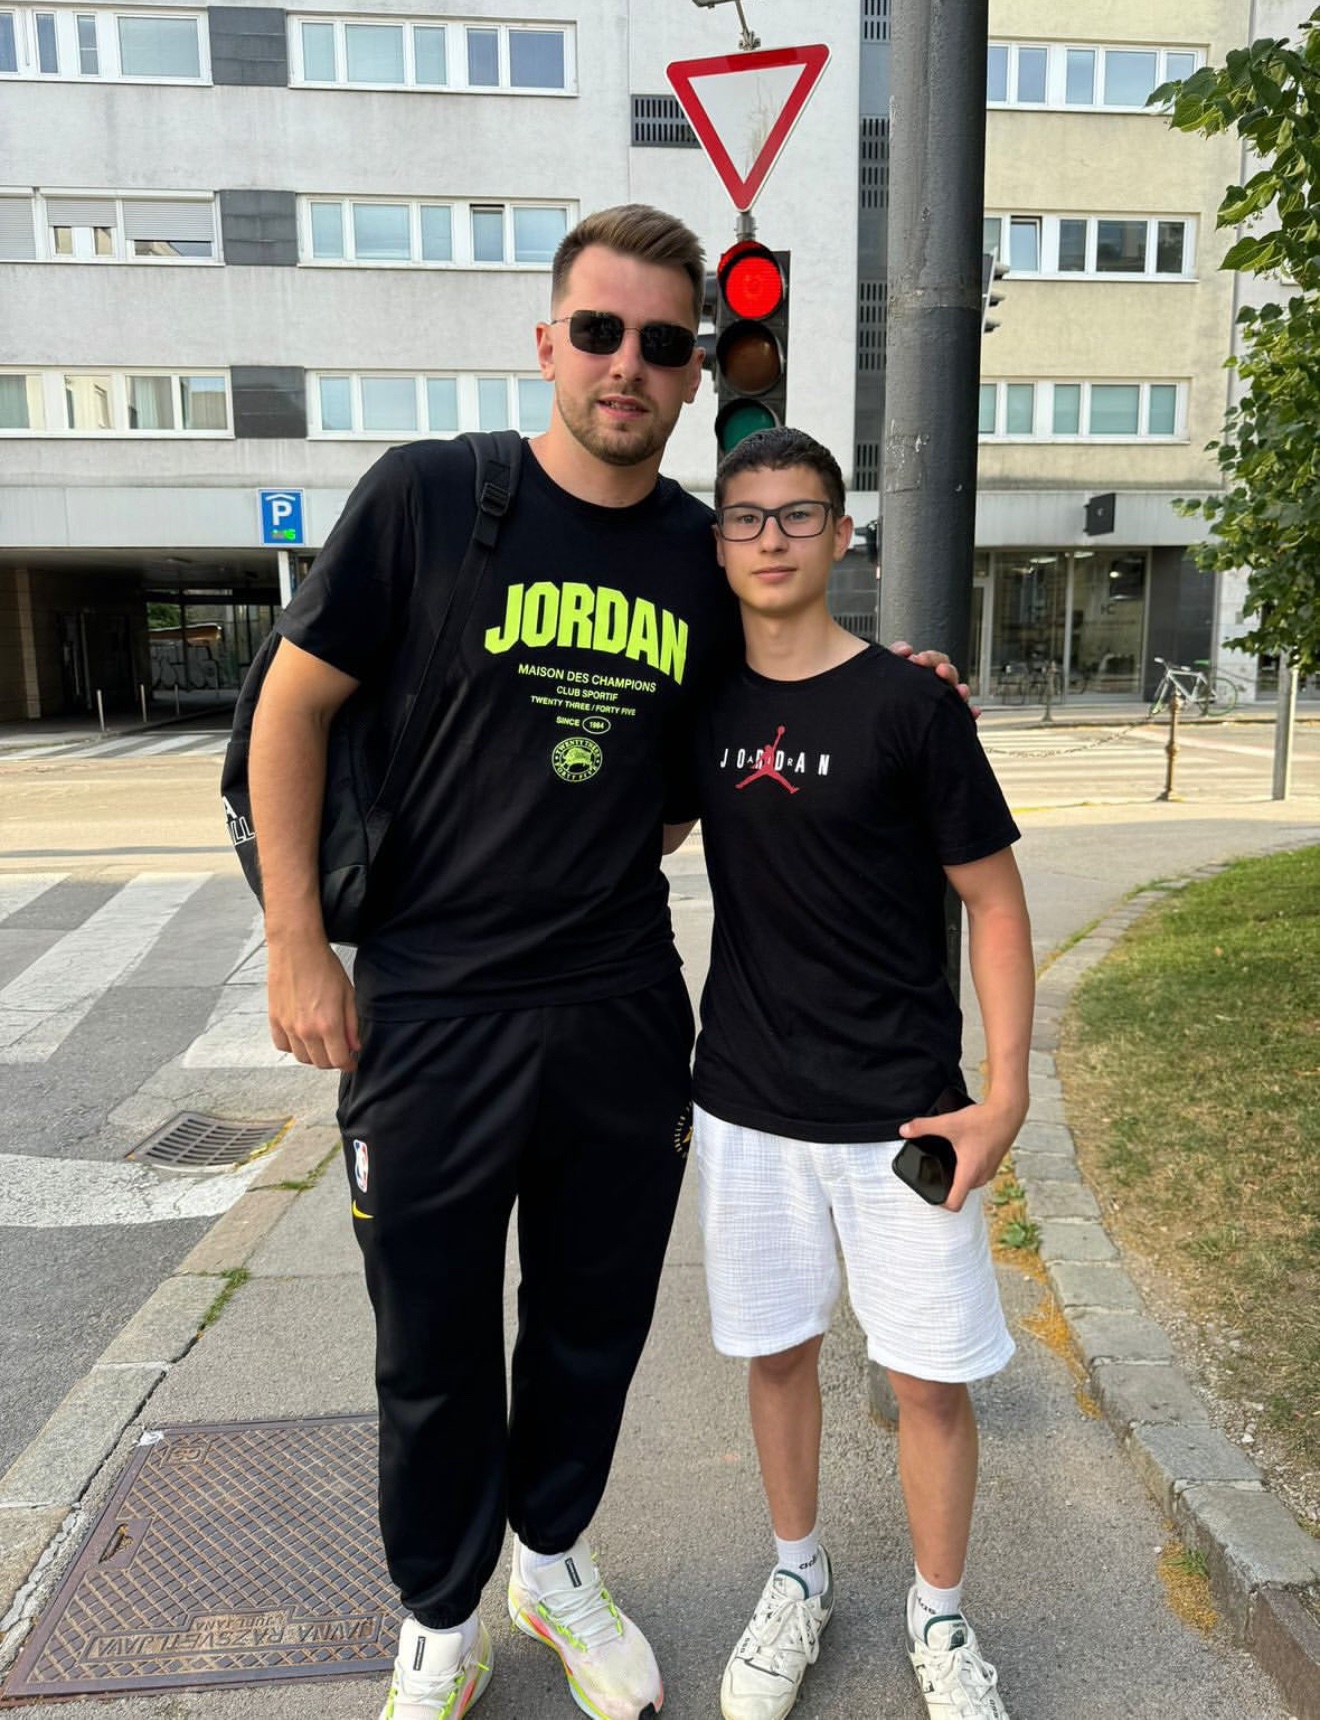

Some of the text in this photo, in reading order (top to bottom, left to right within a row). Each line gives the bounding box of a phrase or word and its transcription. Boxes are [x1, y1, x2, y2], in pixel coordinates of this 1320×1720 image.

[272, 500, 293, 526] P
[484, 581, 689, 686] JORDAN
[518, 663, 656, 693] MAISON DES CHAMPIONS
[530, 695, 563, 707] TWENTY
[565, 701, 590, 711] THREE
[595, 704, 620, 714] FORTY
[621, 708, 636, 716] FIVE
[556, 685, 618, 701] CLUB SPORTIF
[556, 716, 580, 727] SINCE
[719, 748, 830, 776] JORDAN
[298, 1620, 370, 1644] JAVNA
